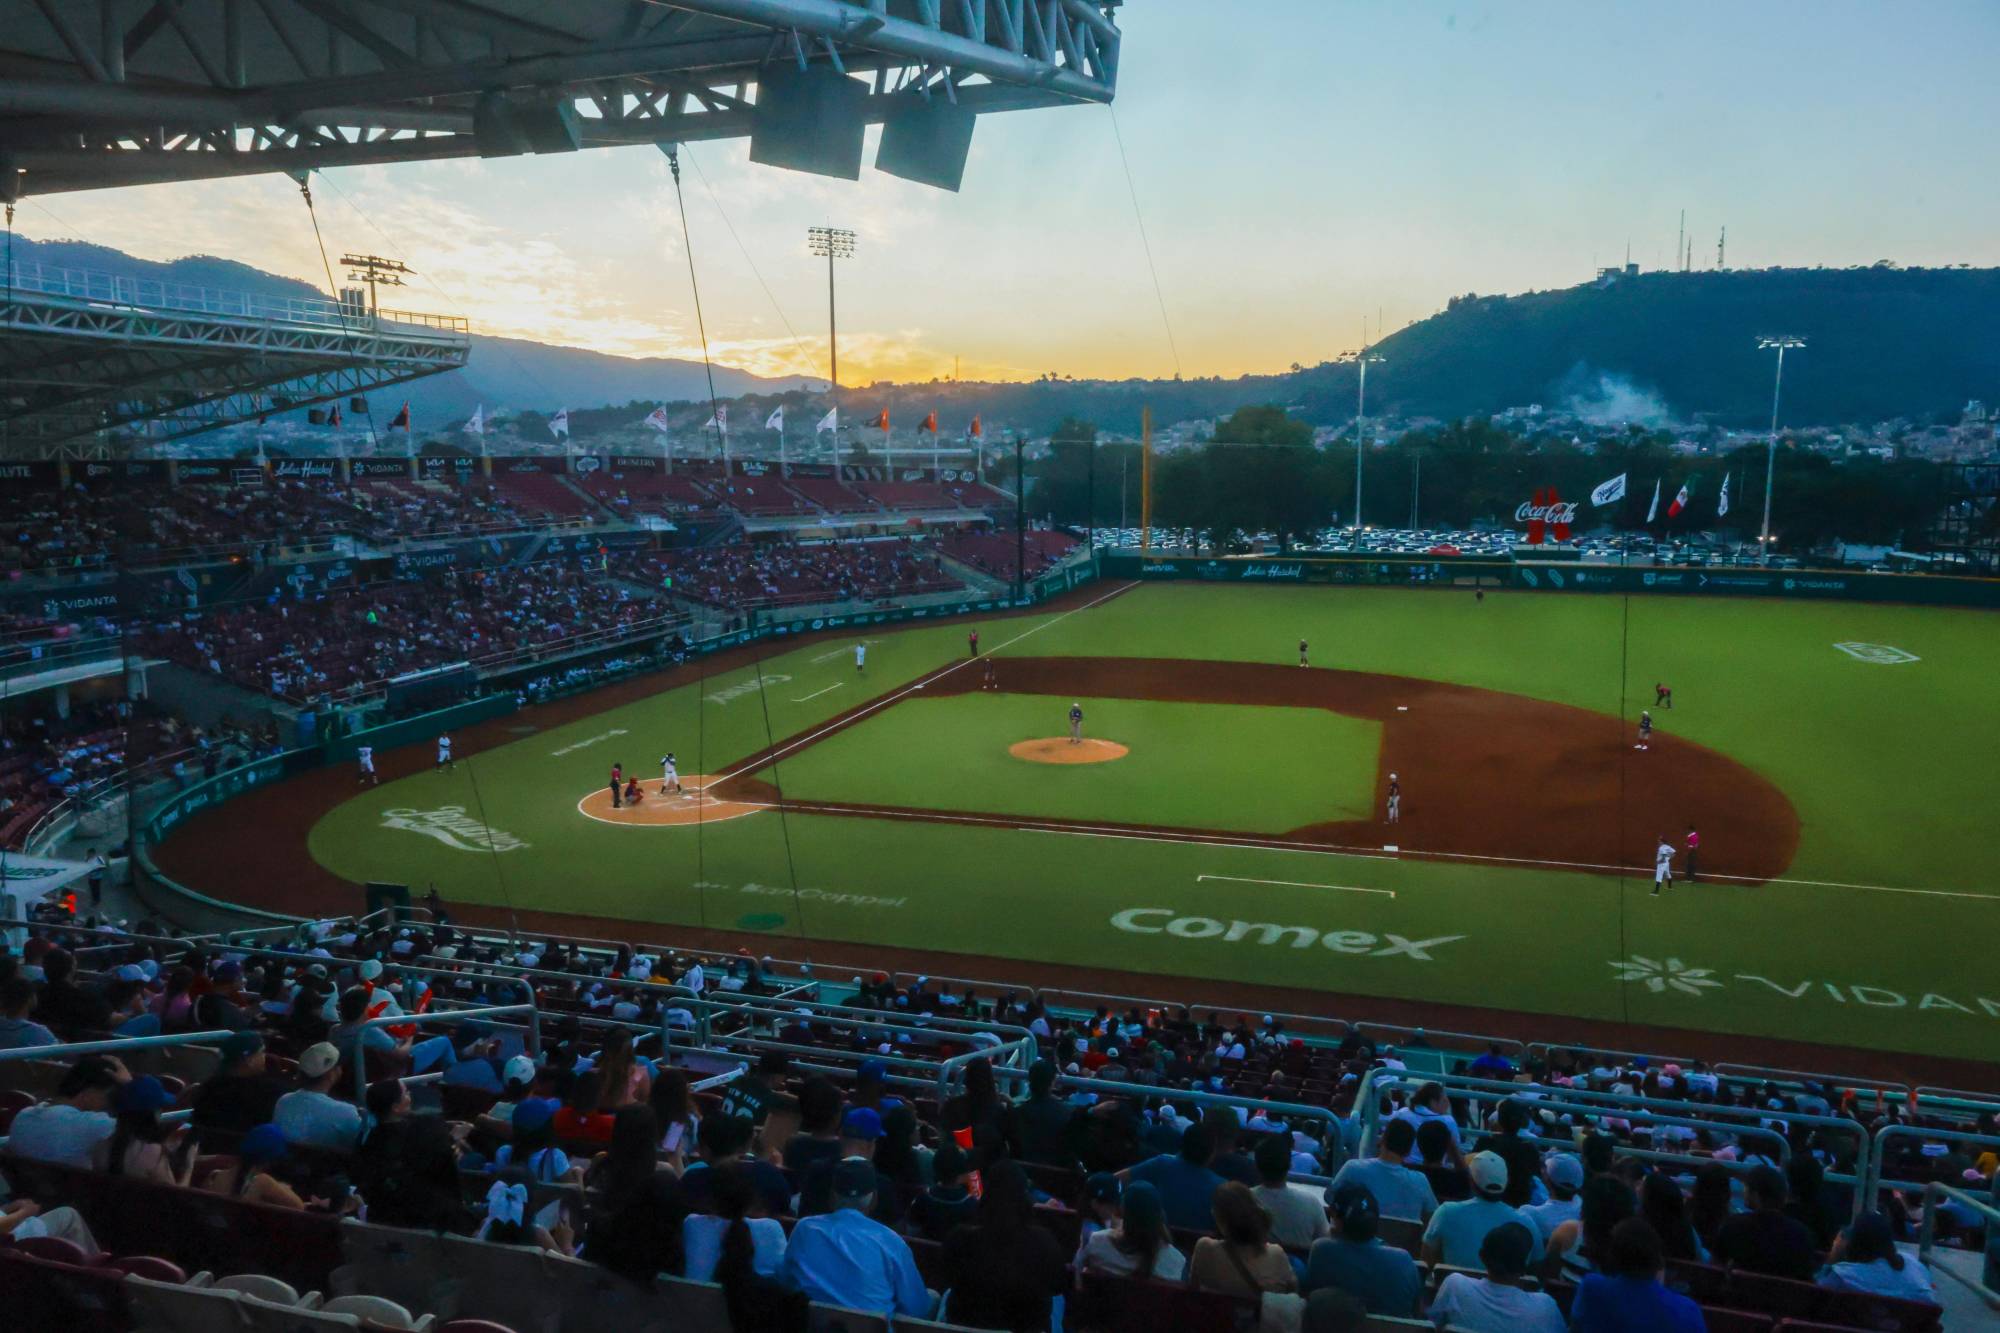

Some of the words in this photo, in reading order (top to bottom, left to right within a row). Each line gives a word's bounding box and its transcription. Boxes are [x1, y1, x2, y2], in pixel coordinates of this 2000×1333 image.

[410, 553, 457, 567] VIDANTA
[1797, 580, 1846, 590] VIDANTA
[62, 595, 118, 609] VIDANTA
[1109, 907, 1471, 961] Comex
